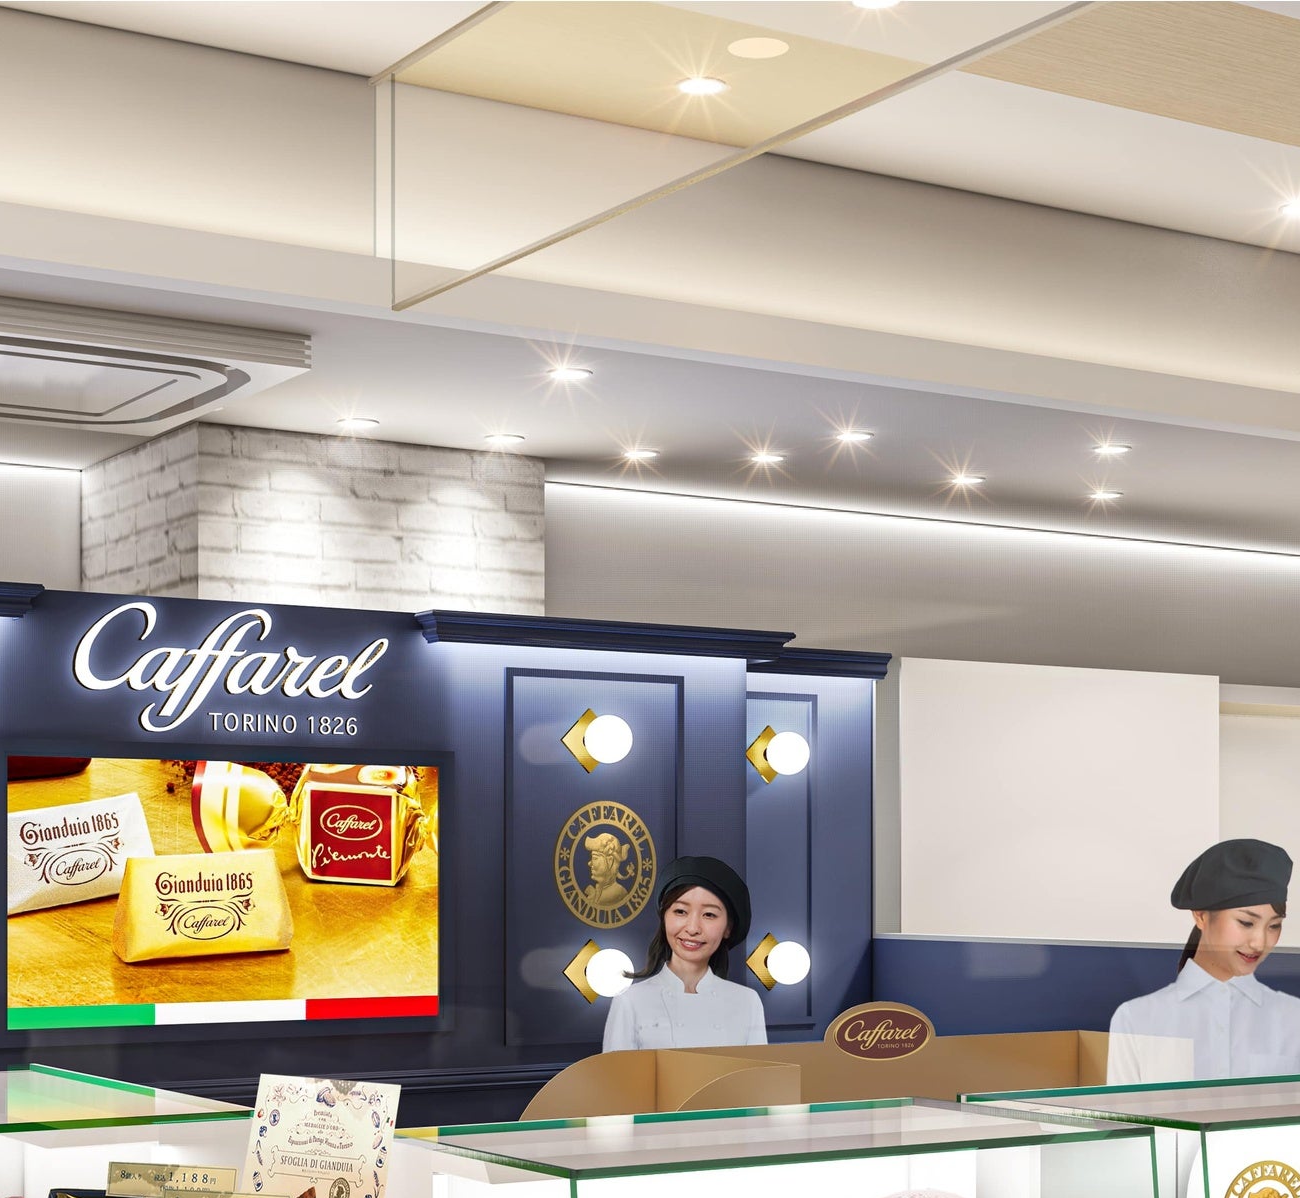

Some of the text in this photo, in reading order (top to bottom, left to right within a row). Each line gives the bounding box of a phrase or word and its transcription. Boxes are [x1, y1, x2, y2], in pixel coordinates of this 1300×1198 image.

[72, 601, 390, 732] Caffarel
[208, 712, 359, 736] TORINO 1826
[19, 811, 120, 845] Gianduia 1865
[326, 812, 377, 835] Caffarel
[566, 805, 647, 851] CAFFAREL
[55, 856, 101, 881] Caffarel
[311, 843, 391, 869] Piemonte
[155, 871, 254, 896] Gianduia 1865
[559, 866, 652, 925] GIANDUIA 1865
[183, 912, 230, 935] Caffarel
[844, 1019, 922, 1051] Caffarel
[280, 1155, 308, 1168] SFOGLIA
[309, 1158, 318, 1169] DI
[319, 1160, 354, 1173] GIANDUIA
